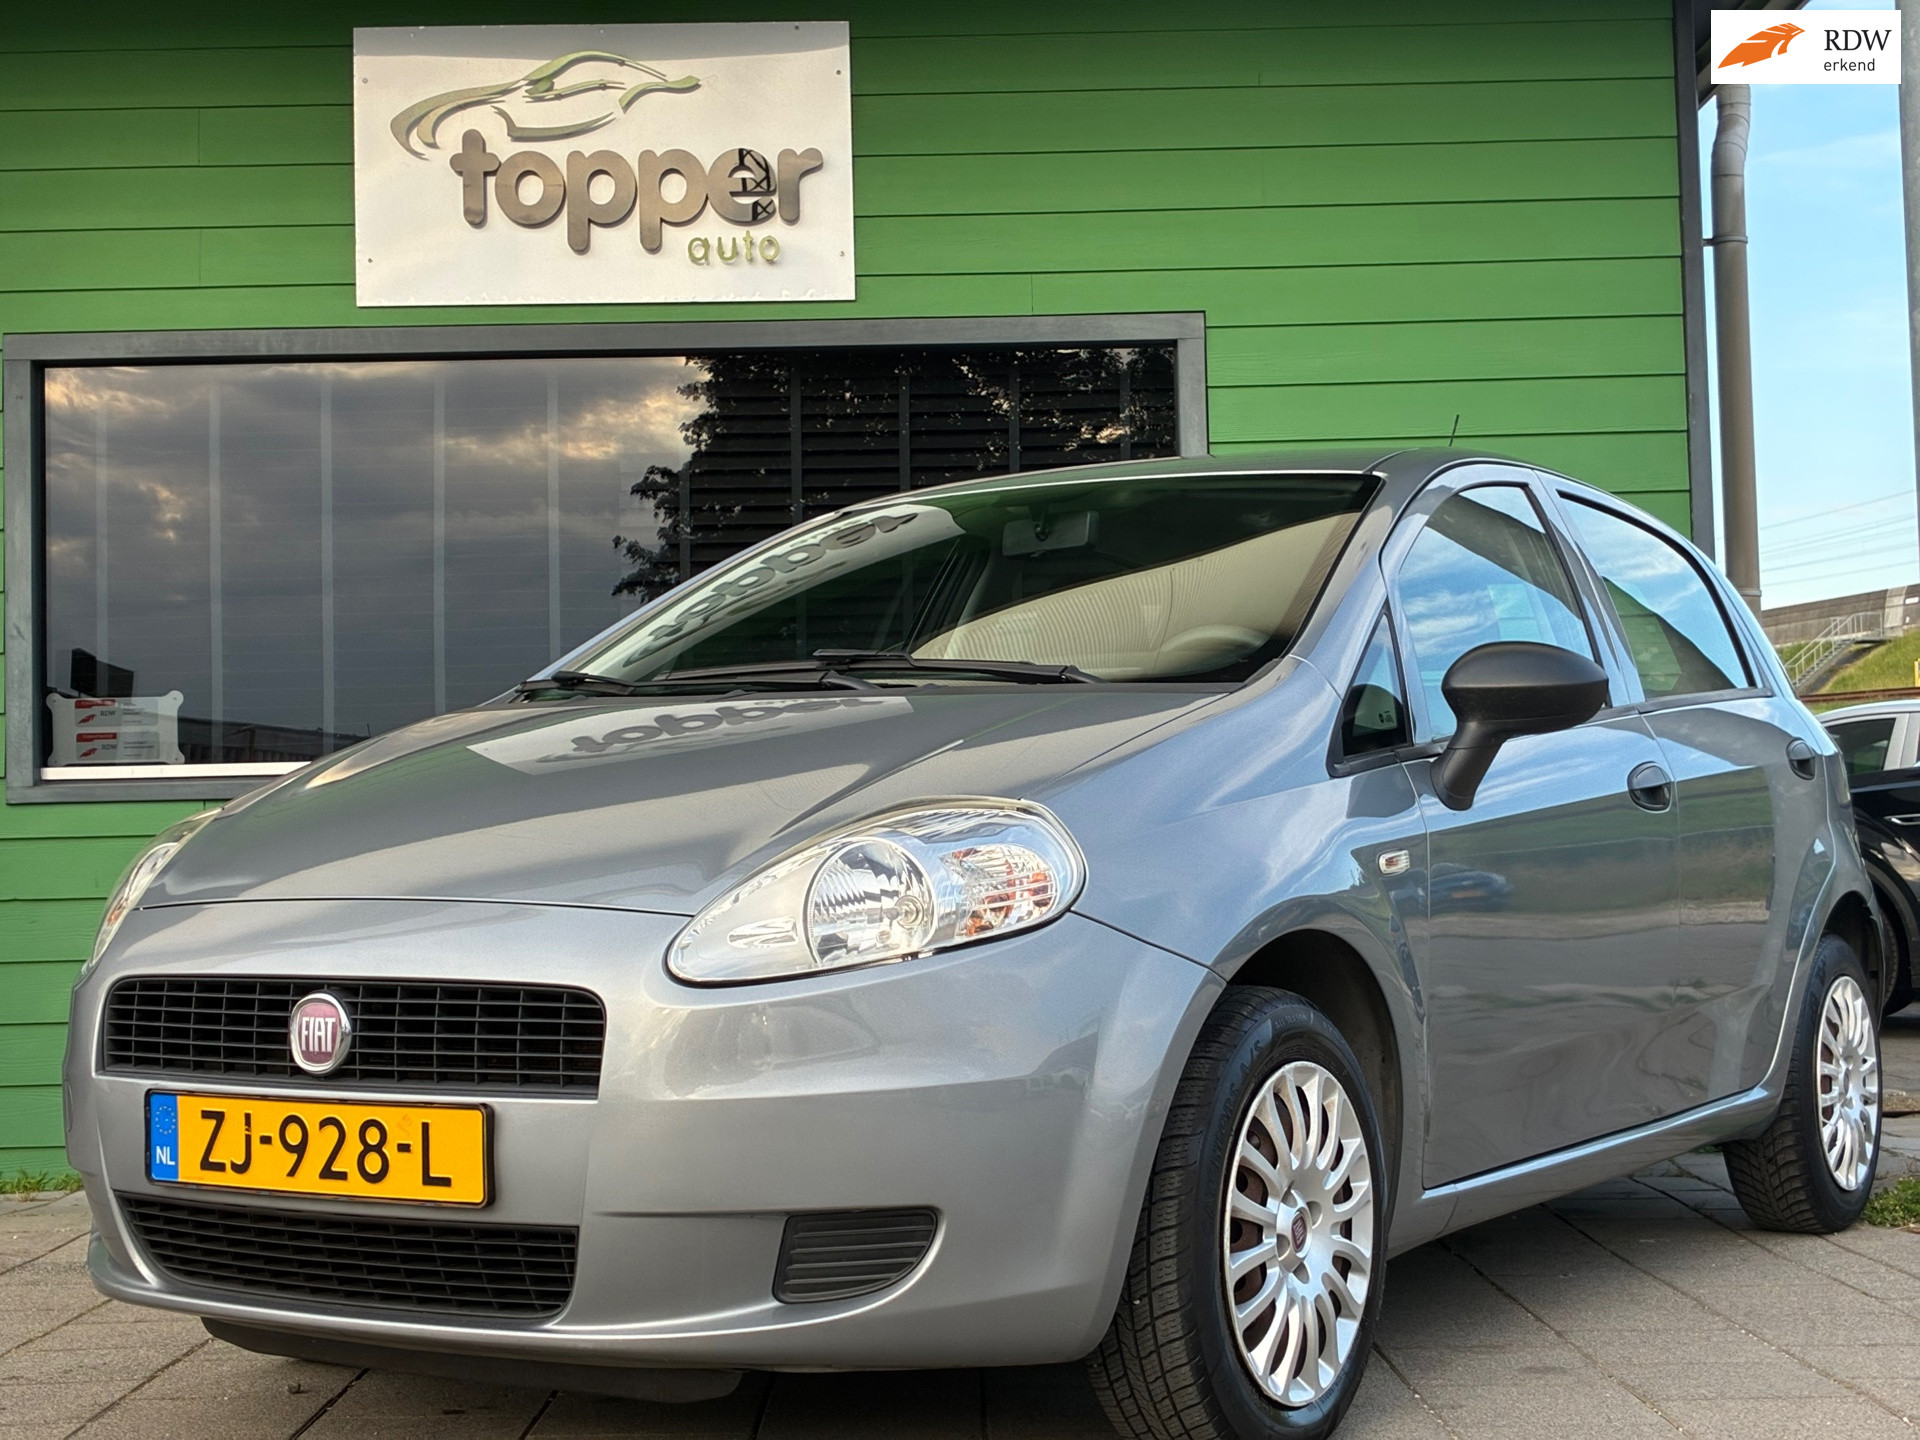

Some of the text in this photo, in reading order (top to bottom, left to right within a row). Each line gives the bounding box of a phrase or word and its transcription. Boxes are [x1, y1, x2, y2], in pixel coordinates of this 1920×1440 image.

[449, 129, 824, 254] topper
[687, 230, 781, 264] auto
[301, 1016, 337, 1053] FIAT
[155, 1145, 176, 1166] NL
[200, 1109, 453, 1188] ZJ-928-L
